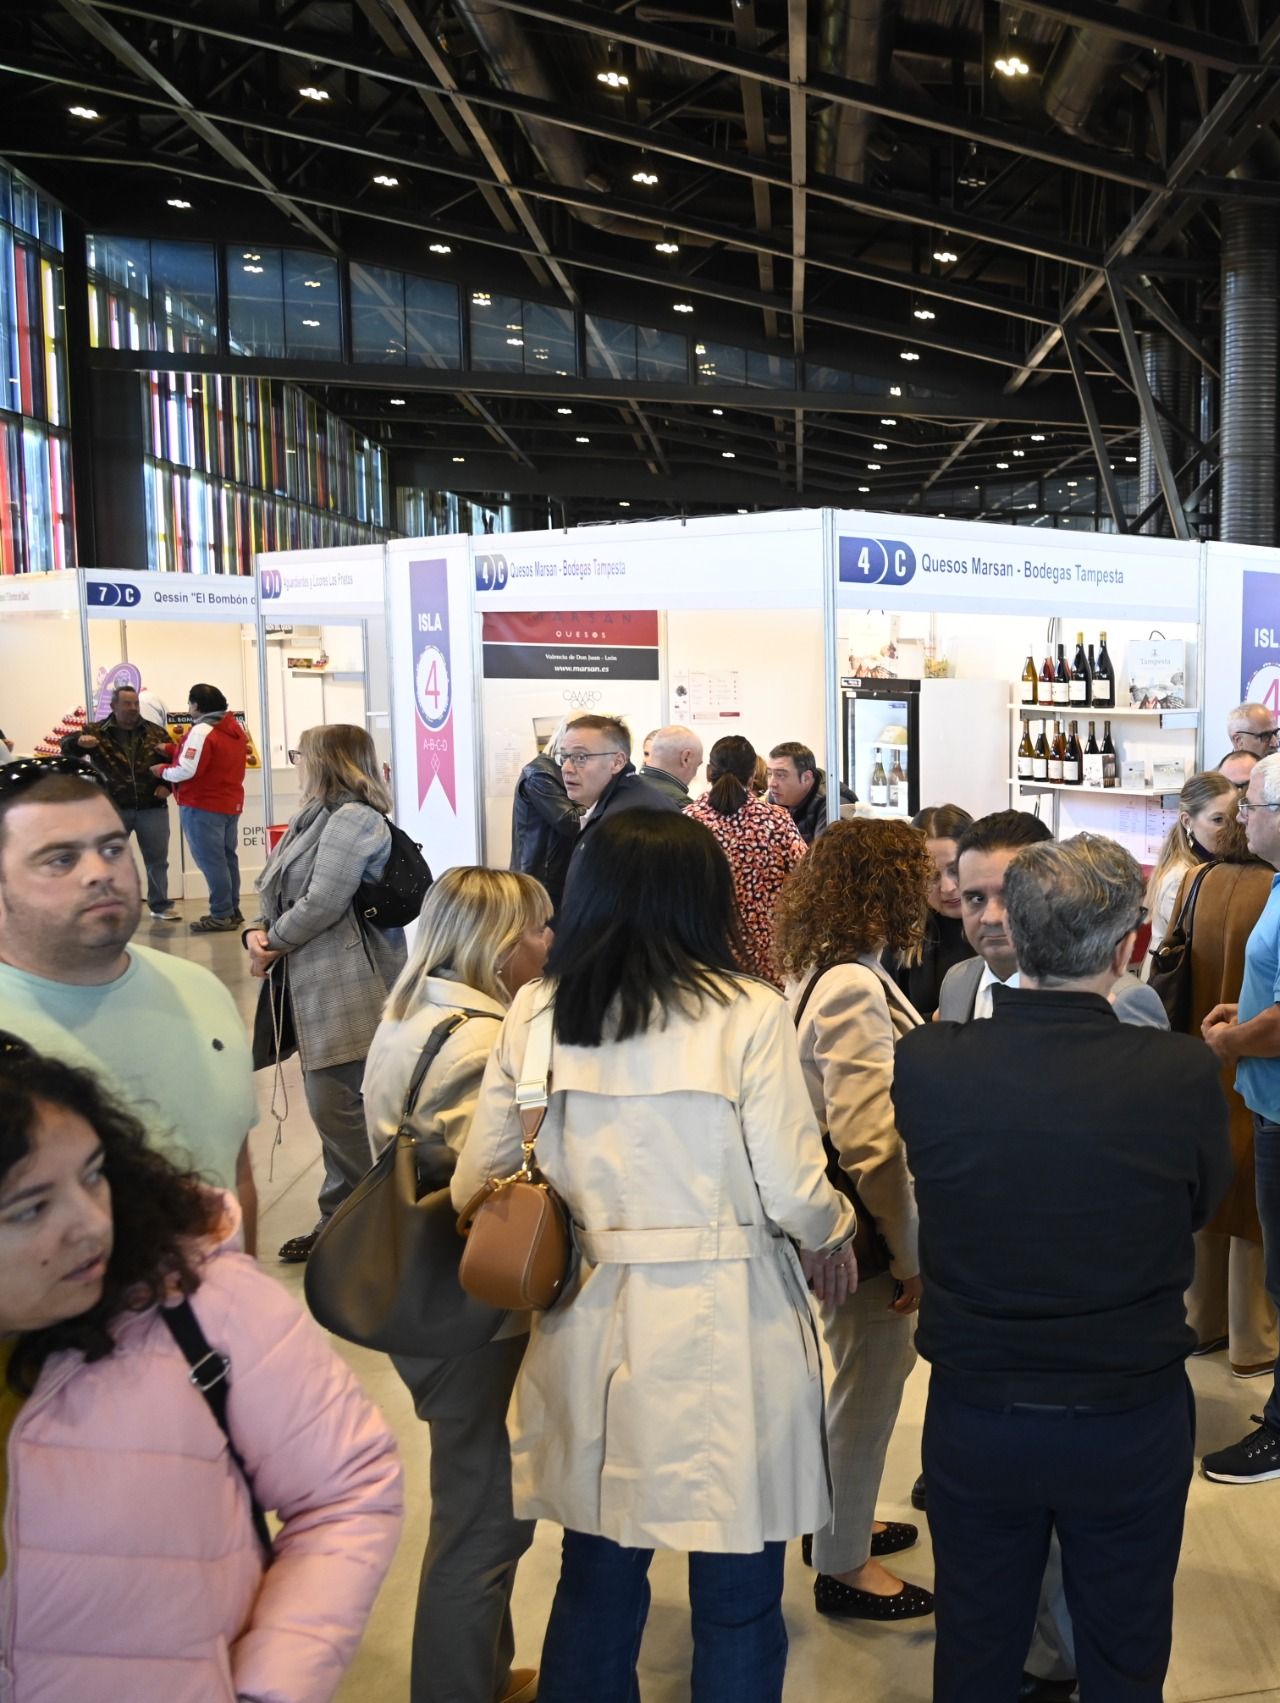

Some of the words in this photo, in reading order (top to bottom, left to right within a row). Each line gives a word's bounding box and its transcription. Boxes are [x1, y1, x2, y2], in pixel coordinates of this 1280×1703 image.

[510, 562, 533, 578] Quesos
[534, 560, 558, 577] Marsan
[563, 559, 592, 580] Bodegas
[593, 558, 626, 580] Tampesta
[858, 546, 871, 575] 4
[894, 549, 907, 577] C
[921, 553, 968, 574] Quesos
[971, 556, 1014, 577] Marsan
[1024, 560, 1072, 584] Bodegas
[1075, 564, 1124, 587] Tampesta
[99, 586, 108, 602] 7
[126, 587, 134, 603] C
[154, 591, 188, 604] Qessin
[209, 592, 248, 605] Bombón
[418, 612, 443, 633] ISLA
[555, 630, 606, 639] QUESOS
[576, 653, 588, 661] Don
[554, 664, 610, 673] www.marsan.es
[424, 660, 441, 710] 4
[243, 837, 258, 847] DE
